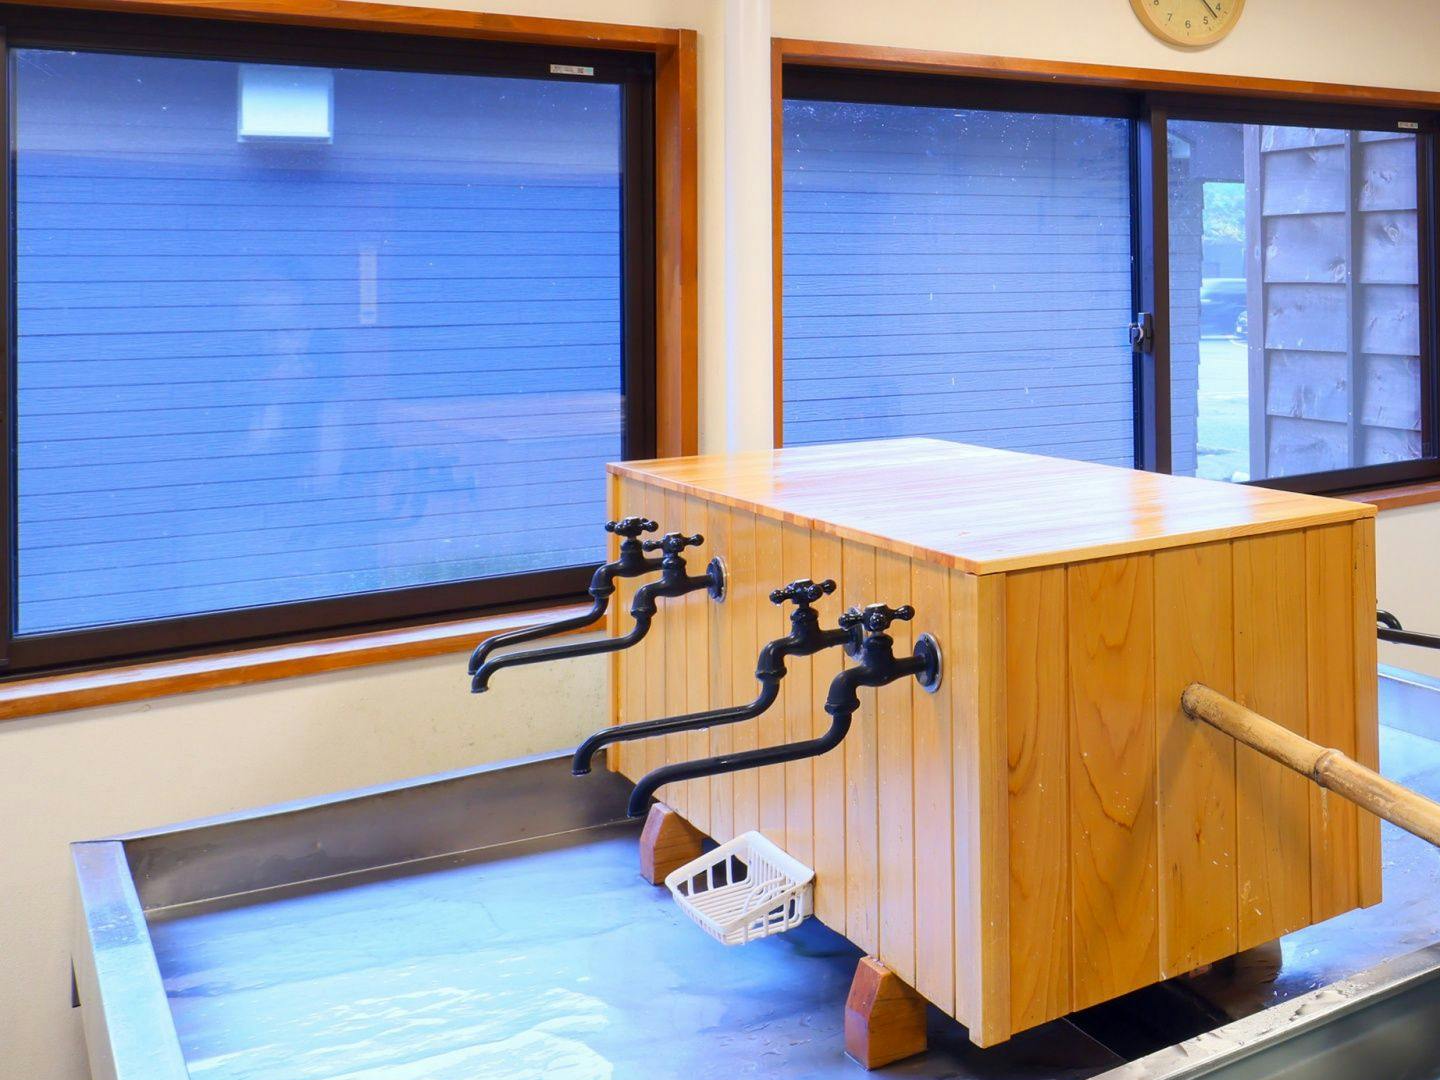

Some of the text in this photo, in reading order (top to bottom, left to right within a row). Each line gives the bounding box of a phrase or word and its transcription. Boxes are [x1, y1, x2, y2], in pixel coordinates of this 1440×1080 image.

[1215, 3, 1221, 11] 4
[1167, 13, 1173, 22] 7
[1203, 17, 1209, 25] 5
[1185, 20, 1191, 29] 6
